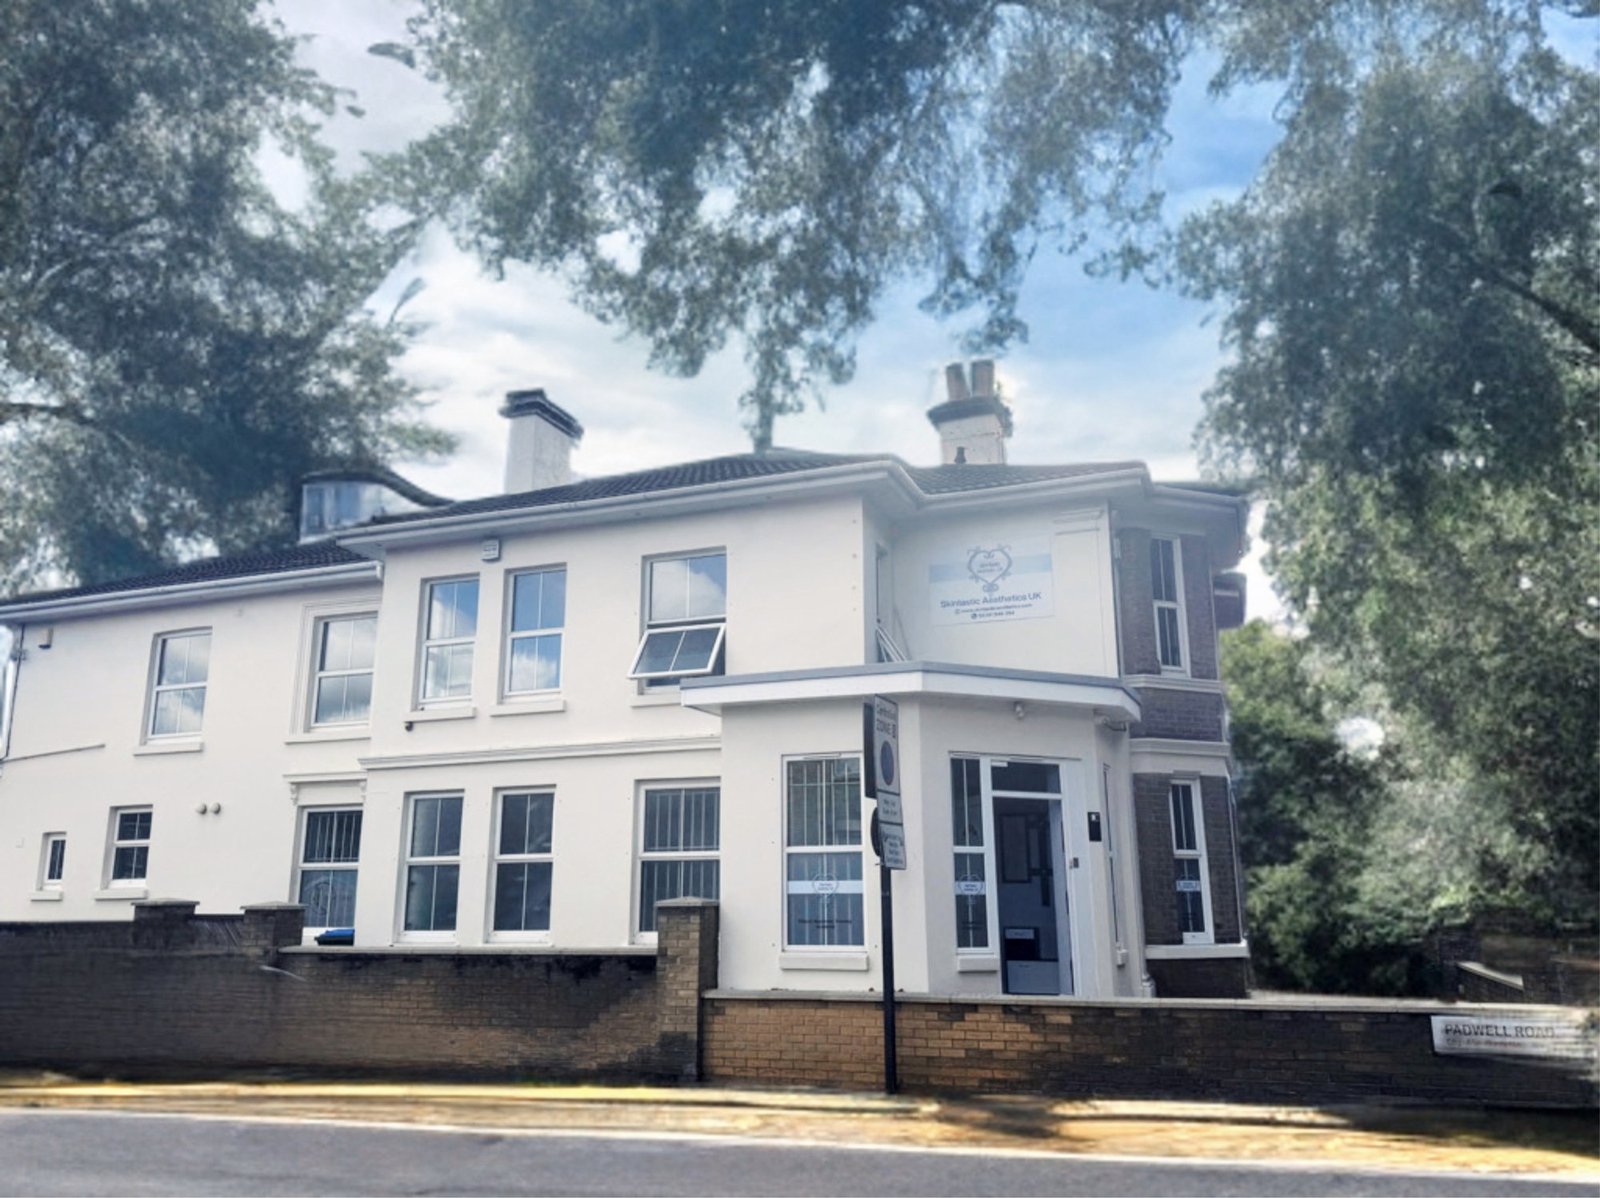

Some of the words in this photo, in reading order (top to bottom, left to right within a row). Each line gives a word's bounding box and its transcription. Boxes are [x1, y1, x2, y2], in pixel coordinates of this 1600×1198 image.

[940, 598, 980, 609] Skintastic
[982, 593, 1027, 605] Aesthetics
[1028, 591, 1042, 601] UK
[1444, 1023, 1512, 1037] PADWELL
[1515, 1025, 1556, 1039] ROAD
